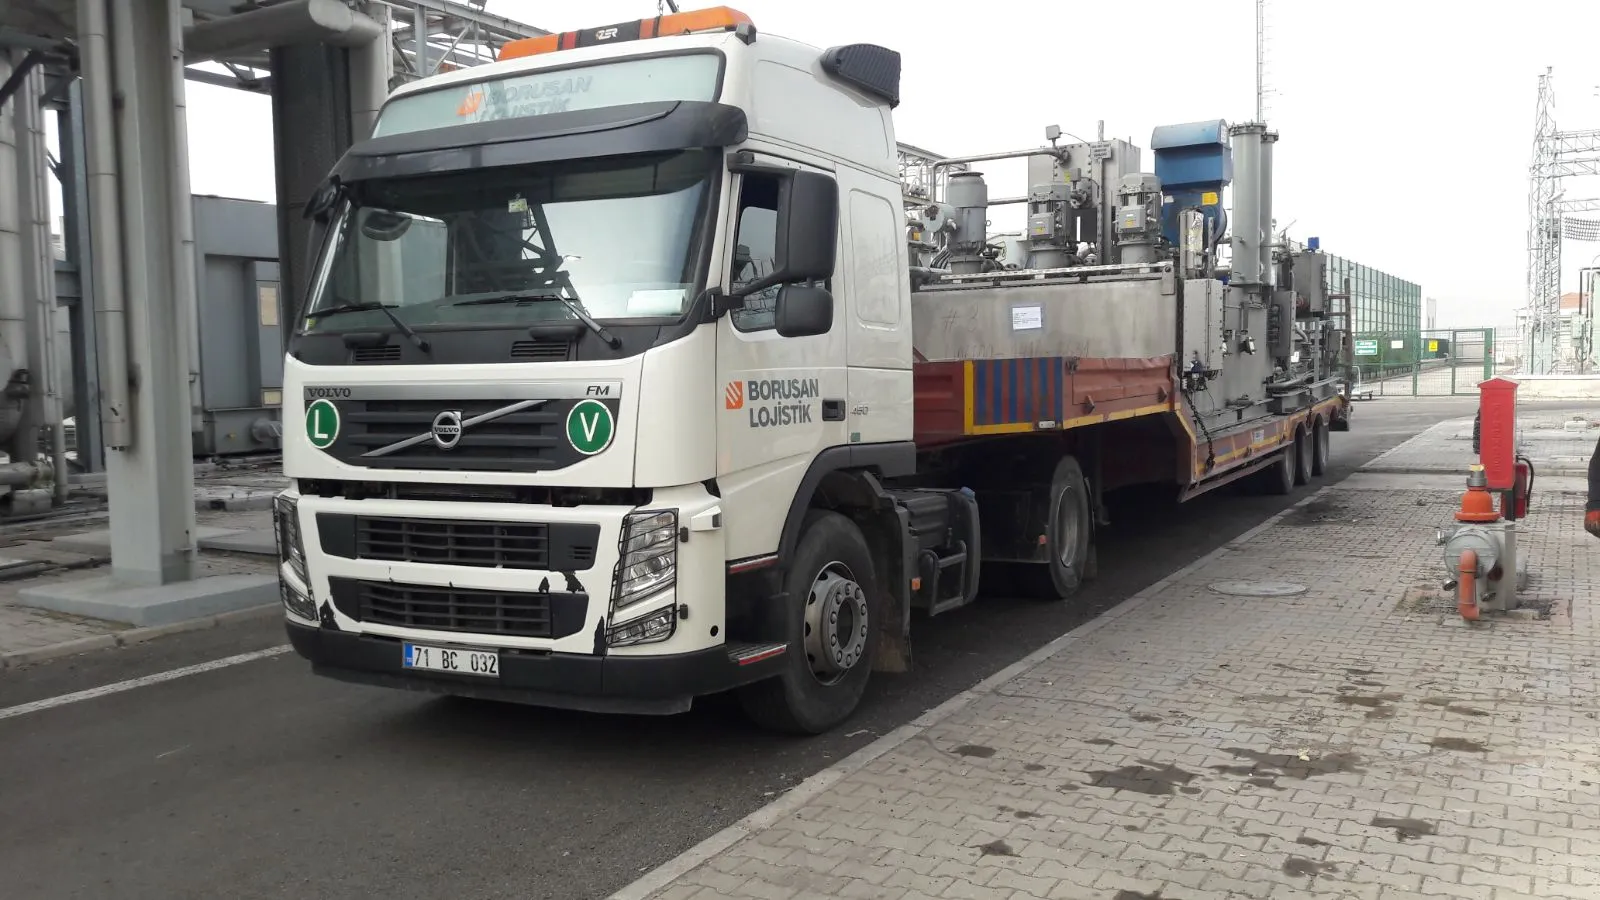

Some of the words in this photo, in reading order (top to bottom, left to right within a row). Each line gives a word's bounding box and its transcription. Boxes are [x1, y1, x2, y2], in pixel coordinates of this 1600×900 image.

[307, 387, 352, 398] VOLVO
[586, 385, 610, 396] FM
[747, 379, 819, 400] BORUSAN
[314, 409, 329, 439] L
[580, 412, 600, 442] V
[749, 401, 812, 428] LOJİSTİK
[414, 647, 429, 668] 71
[441, 650, 458, 670] BC
[470, 653, 497, 674] 032
